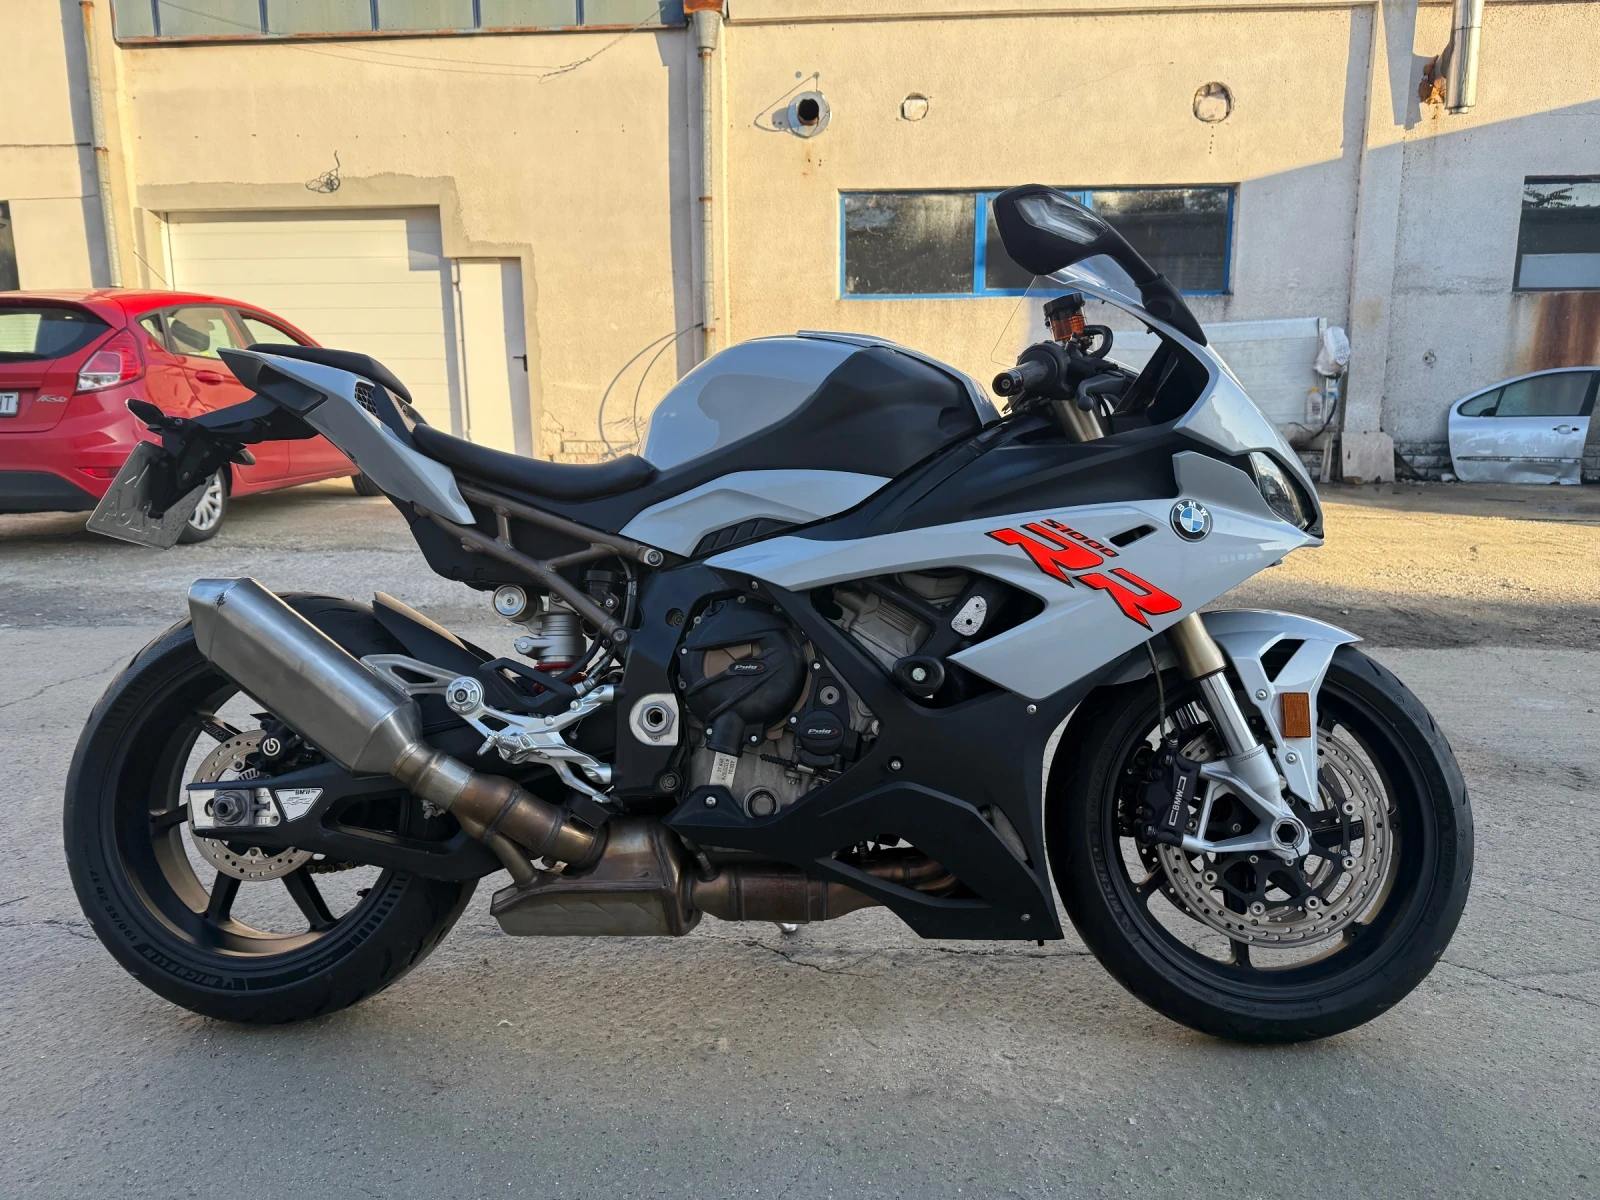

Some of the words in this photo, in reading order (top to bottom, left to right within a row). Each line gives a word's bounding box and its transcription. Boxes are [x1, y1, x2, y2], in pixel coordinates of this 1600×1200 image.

[1176, 500, 1208, 516] BMW
[1040, 518, 1120, 558] S1000
[984, 522, 1182, 632] RR
[1171, 788, 1184, 811] BMW
[88, 869, 100, 883] 17
[95, 886, 109, 903] ZR
[107, 904, 138, 943] 190/55
[141, 945, 223, 987] MICHELIN
